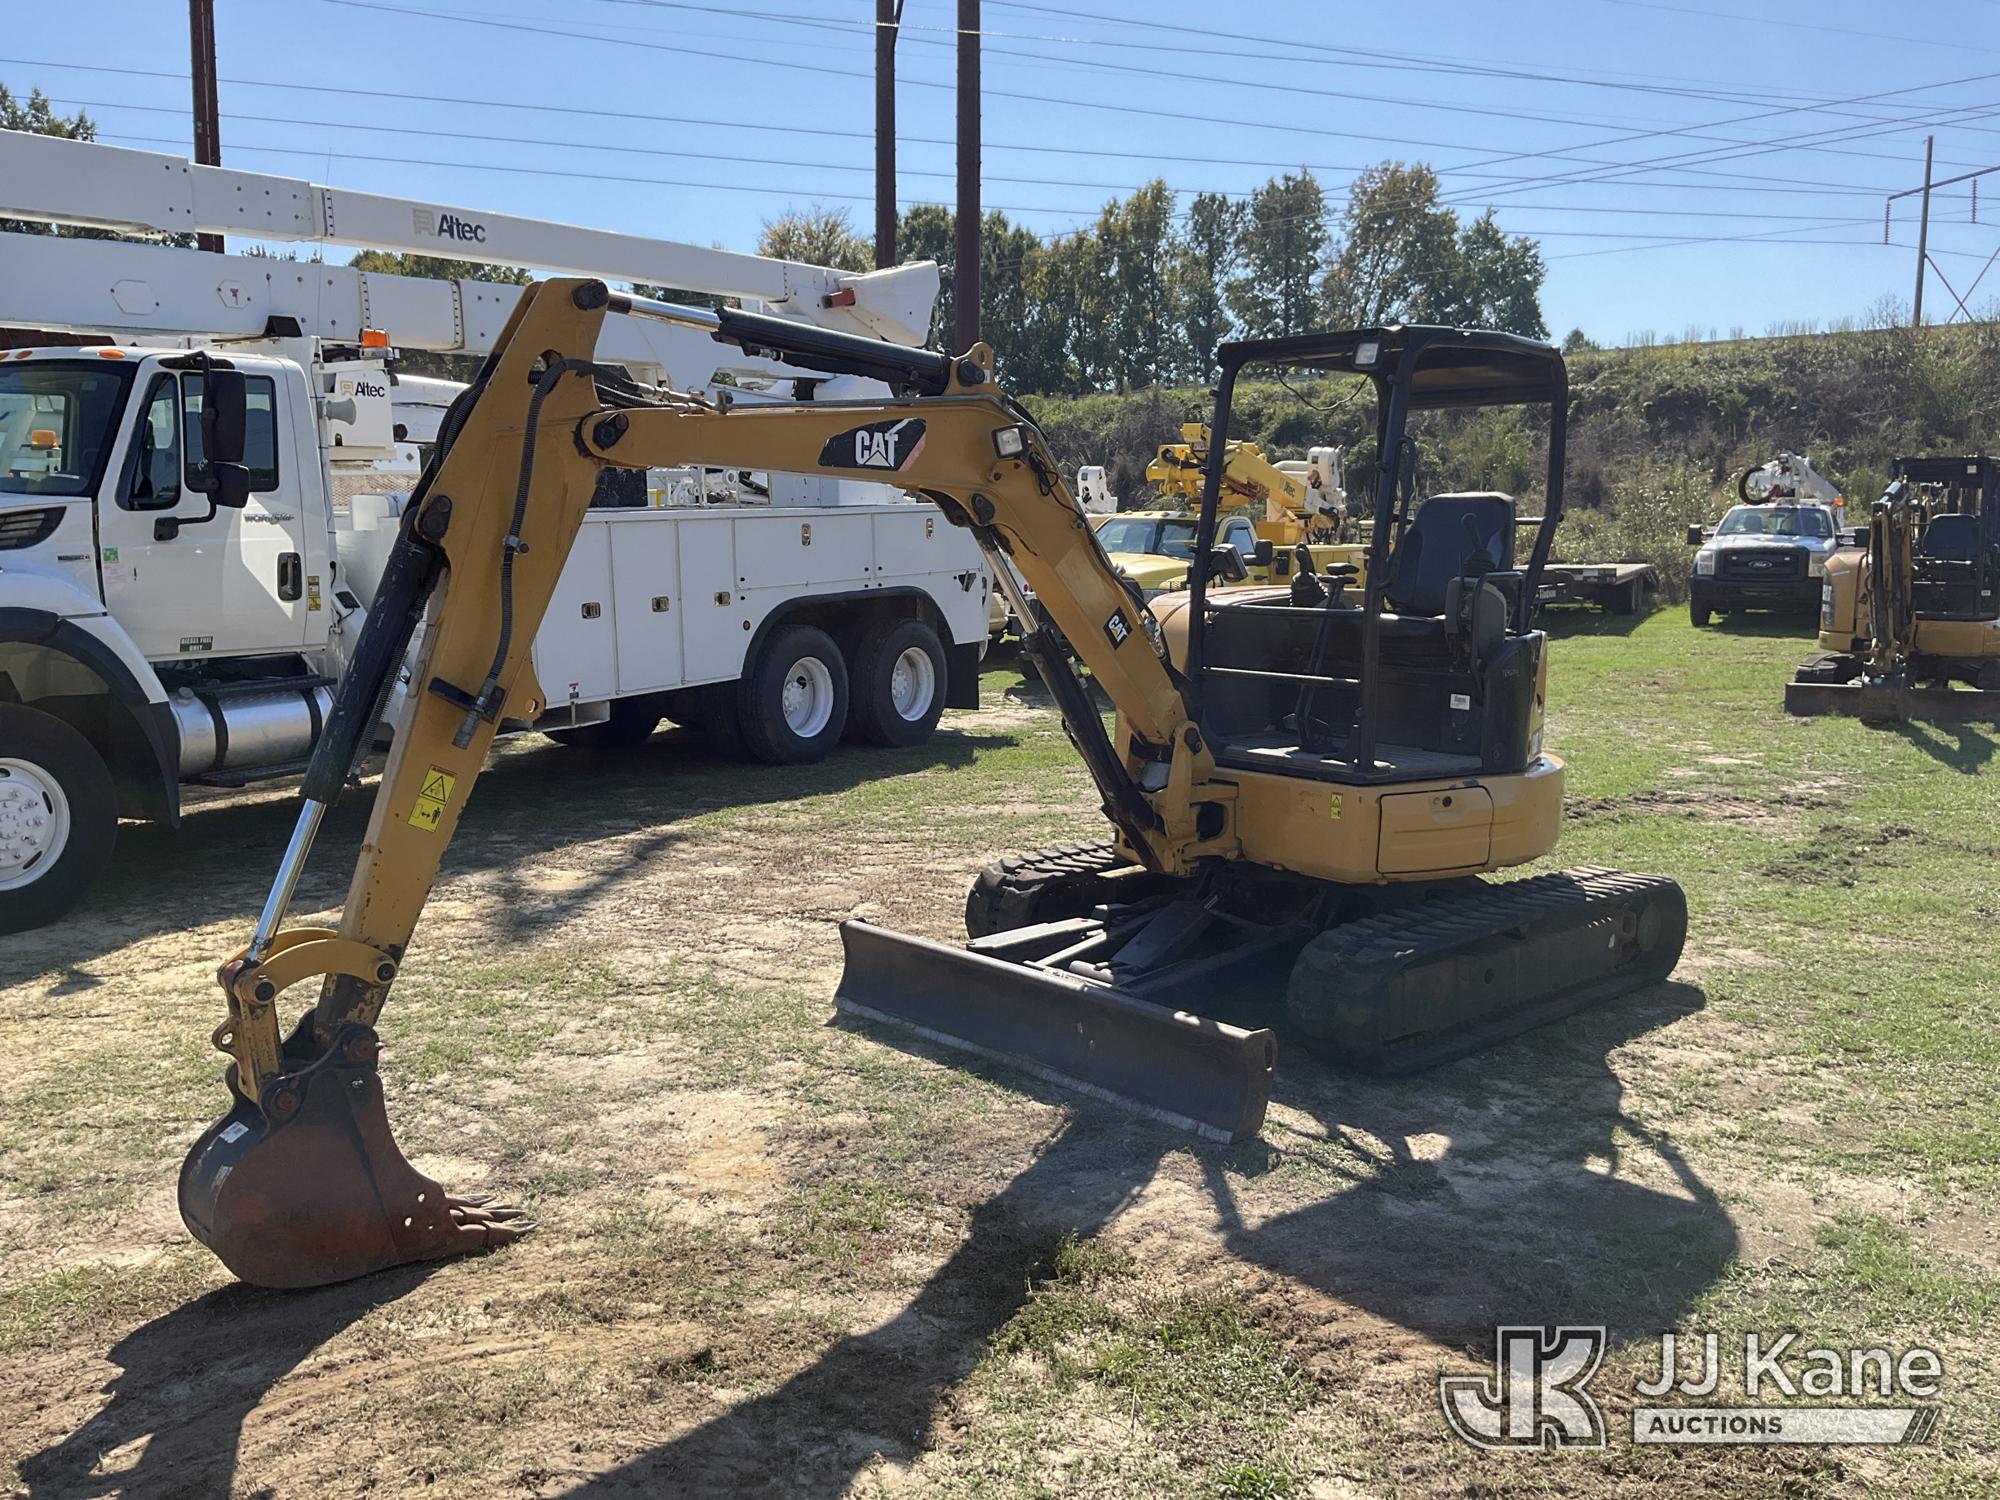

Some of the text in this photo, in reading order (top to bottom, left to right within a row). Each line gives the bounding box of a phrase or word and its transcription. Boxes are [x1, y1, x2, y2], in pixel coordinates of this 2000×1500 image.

[438, 214, 487, 243] Altec
[355, 381, 385, 398] Altec
[855, 429, 899, 467] CAT
[1108, 614, 1128, 642] CAT
